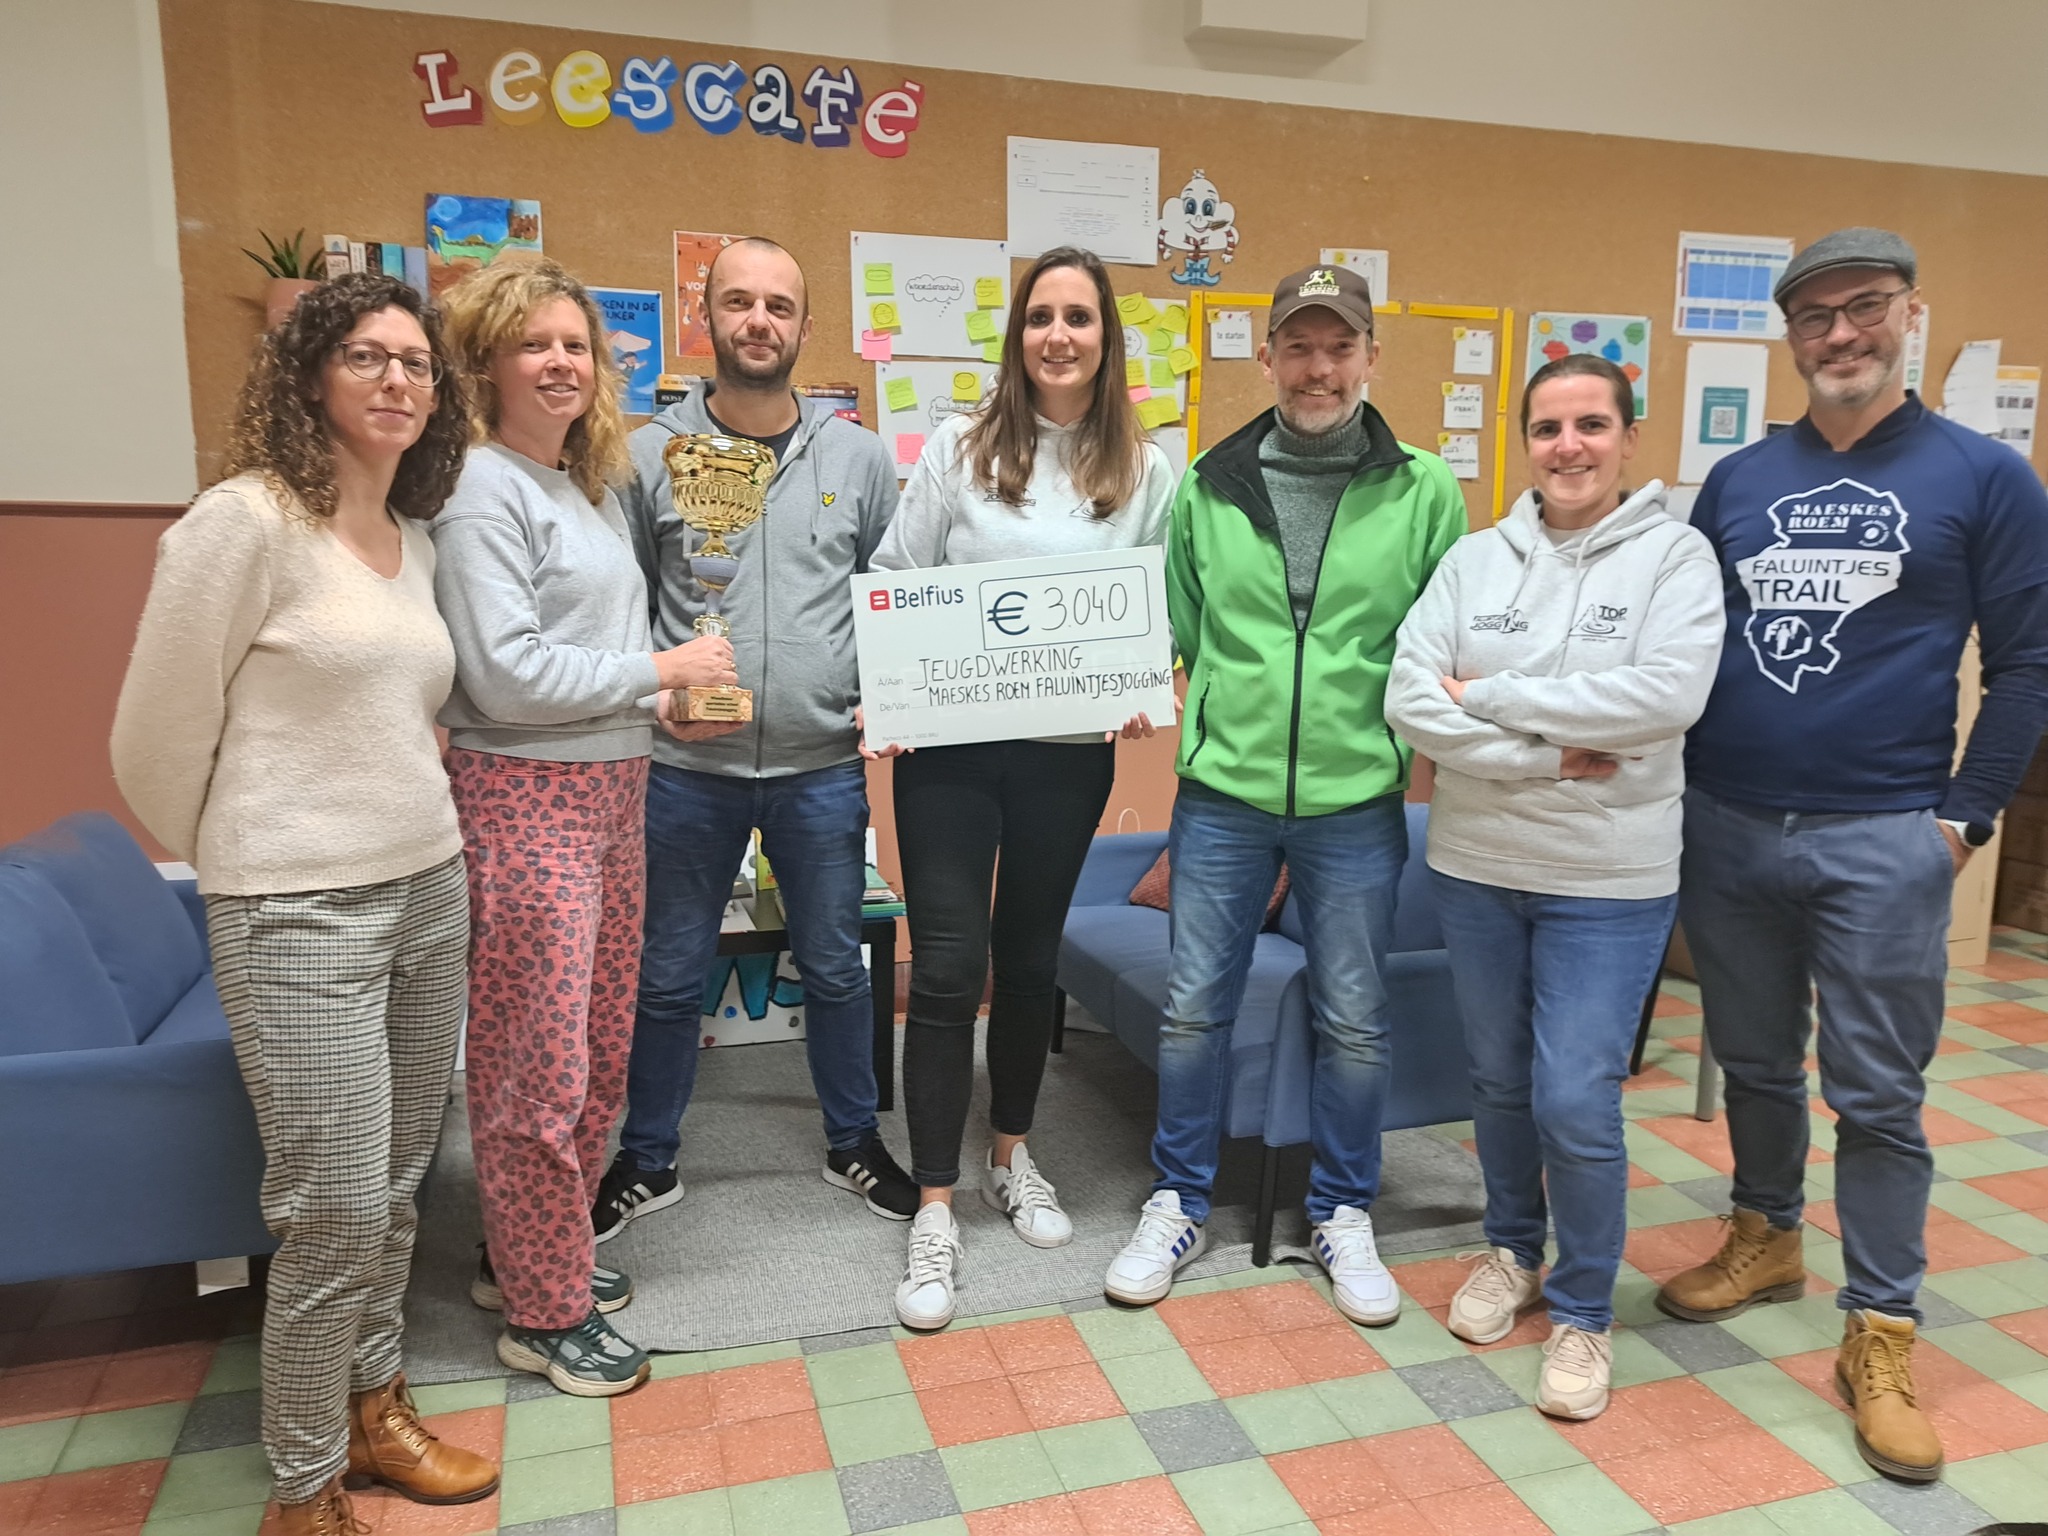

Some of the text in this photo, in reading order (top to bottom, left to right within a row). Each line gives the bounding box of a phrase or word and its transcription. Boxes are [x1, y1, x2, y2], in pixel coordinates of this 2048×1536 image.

[628, 302, 639, 310] IN
[643, 302, 656, 312] DE
[1790, 503, 1893, 517] MAESKES
[1787, 516, 1850, 529] ROEM
[1752, 558, 1890, 576] FALUINTJES
[894, 585, 964, 609] Belfius
[1752, 579, 1851, 604] TRAIL
[986, 583, 1128, 636] € 3.040
[912, 645, 1083, 691] JEUGDWERKING
[877, 677, 904, 687] A/Aan
[929, 682, 990, 707] MAESKES
[996, 681, 1030, 701] ROEM
[879, 702, 910, 712] De/Van
